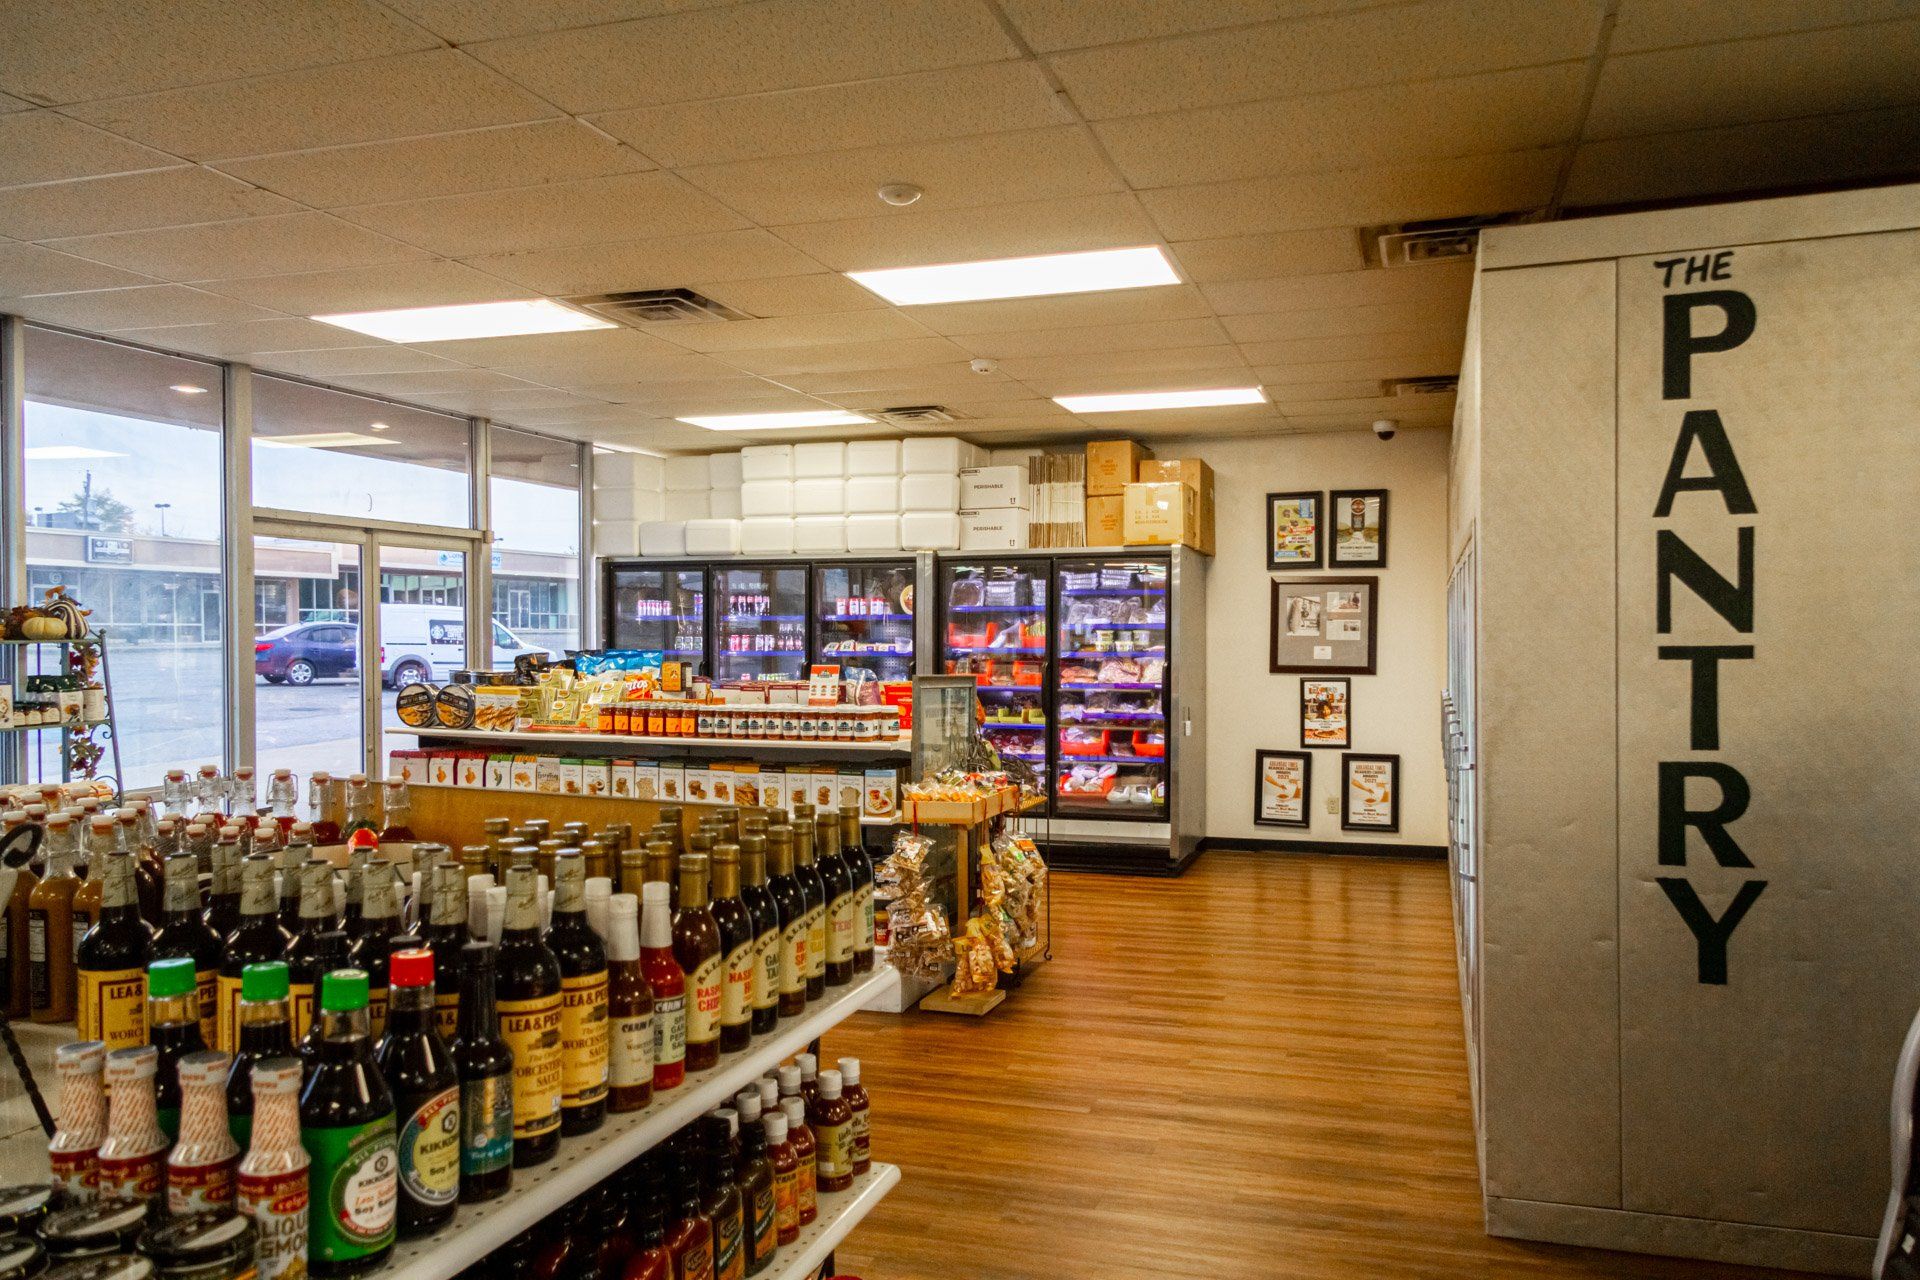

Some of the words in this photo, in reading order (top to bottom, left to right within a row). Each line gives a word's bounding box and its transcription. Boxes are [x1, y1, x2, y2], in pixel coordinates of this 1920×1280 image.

[1654, 251, 1735, 288] THE
[1653, 290, 1768, 985] PANTRY
[110, 986, 132, 1000] LEA
[134, 984, 143, 997] &
[563, 991, 585, 1007] LEA
[509, 1015, 531, 1032] LEA
[260, 1214, 308, 1236] LIQU
